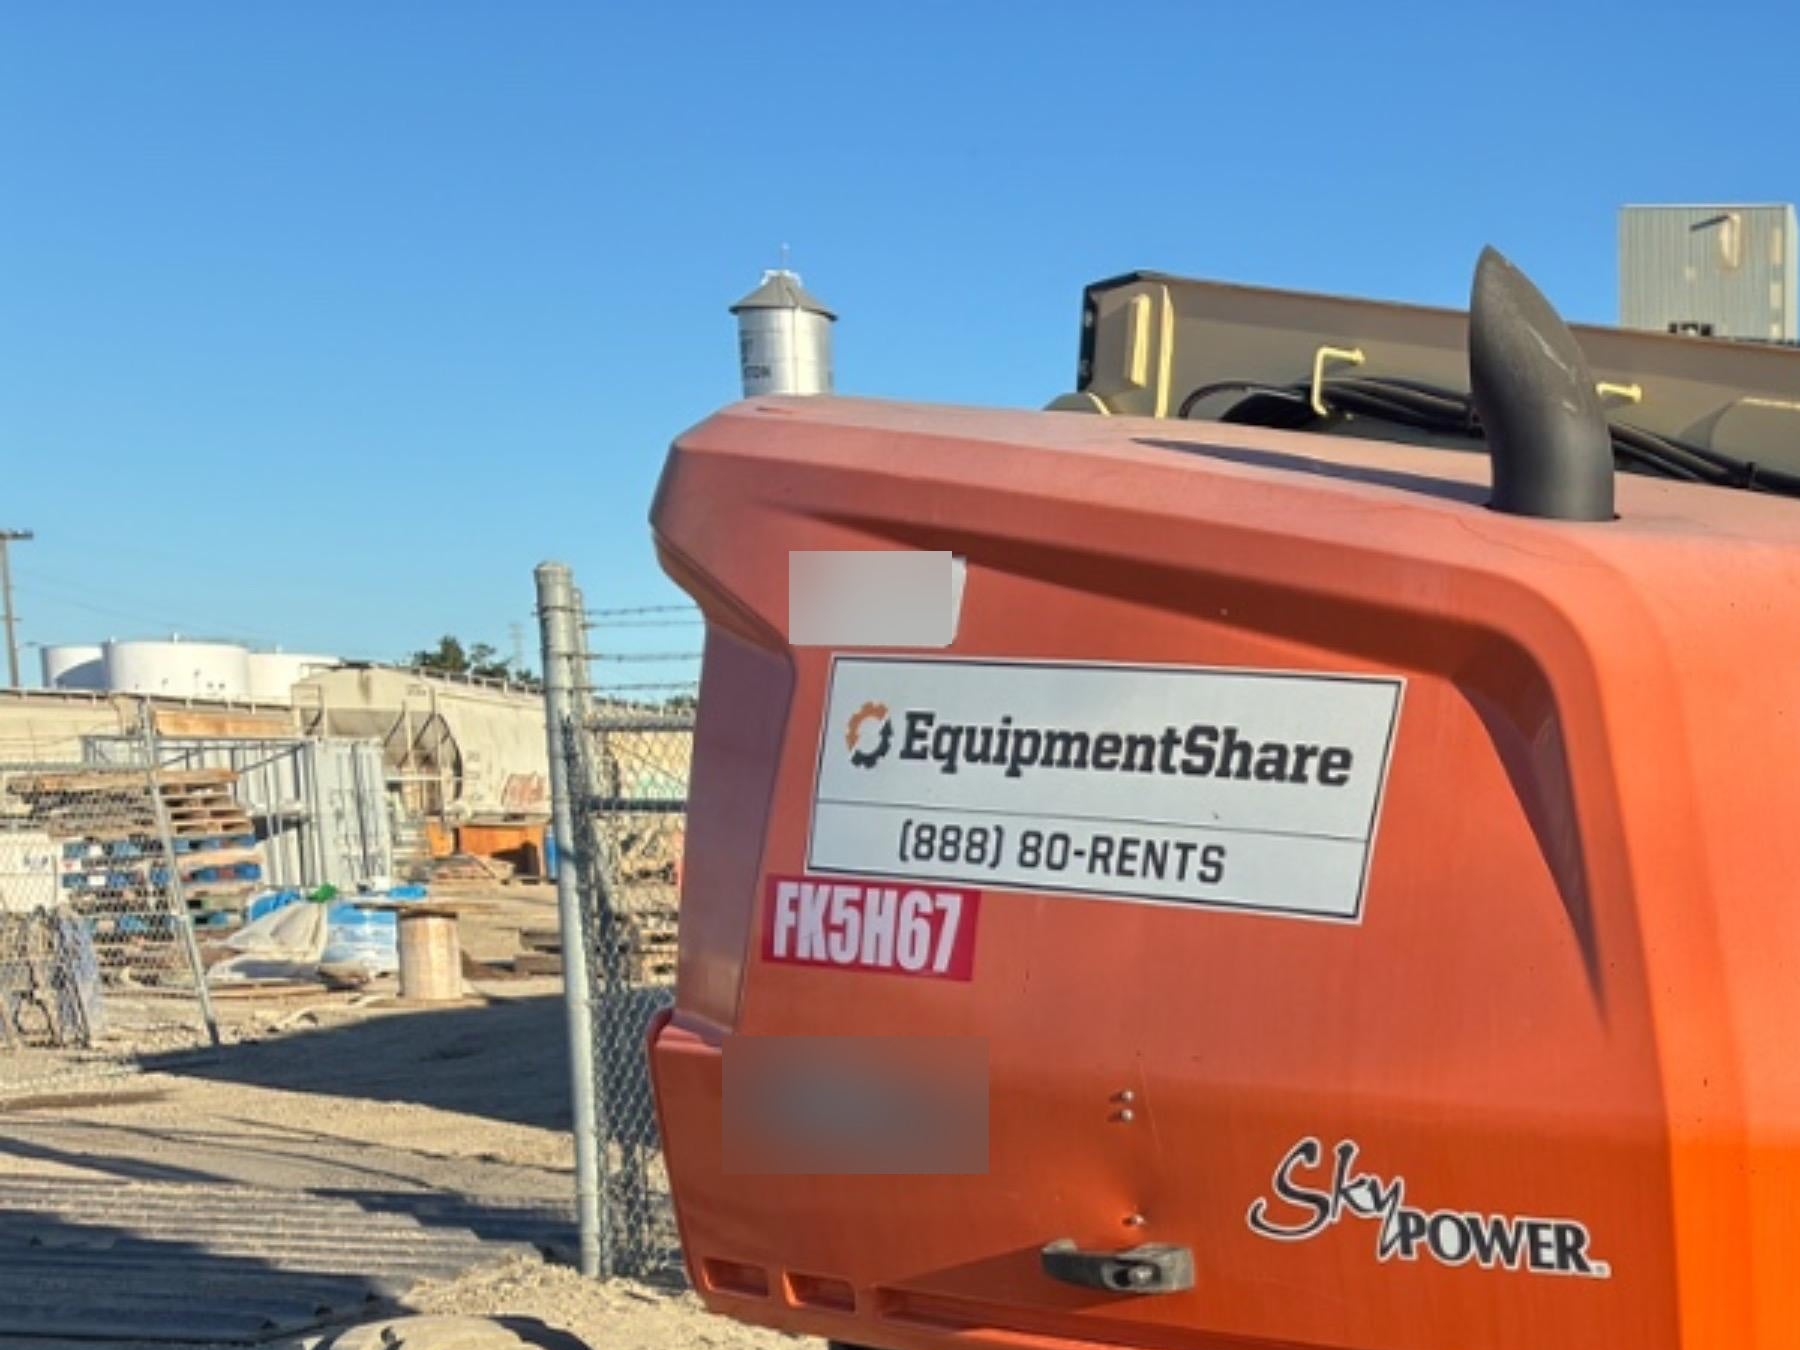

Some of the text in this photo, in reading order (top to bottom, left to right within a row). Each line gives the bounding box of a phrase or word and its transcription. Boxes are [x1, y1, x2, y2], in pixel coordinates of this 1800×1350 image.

[900, 710, 1353, 788] EquipmentShare
[899, 818, 1227, 884] (888) 80-RENTS
[772, 881, 963, 974] FK5H67
